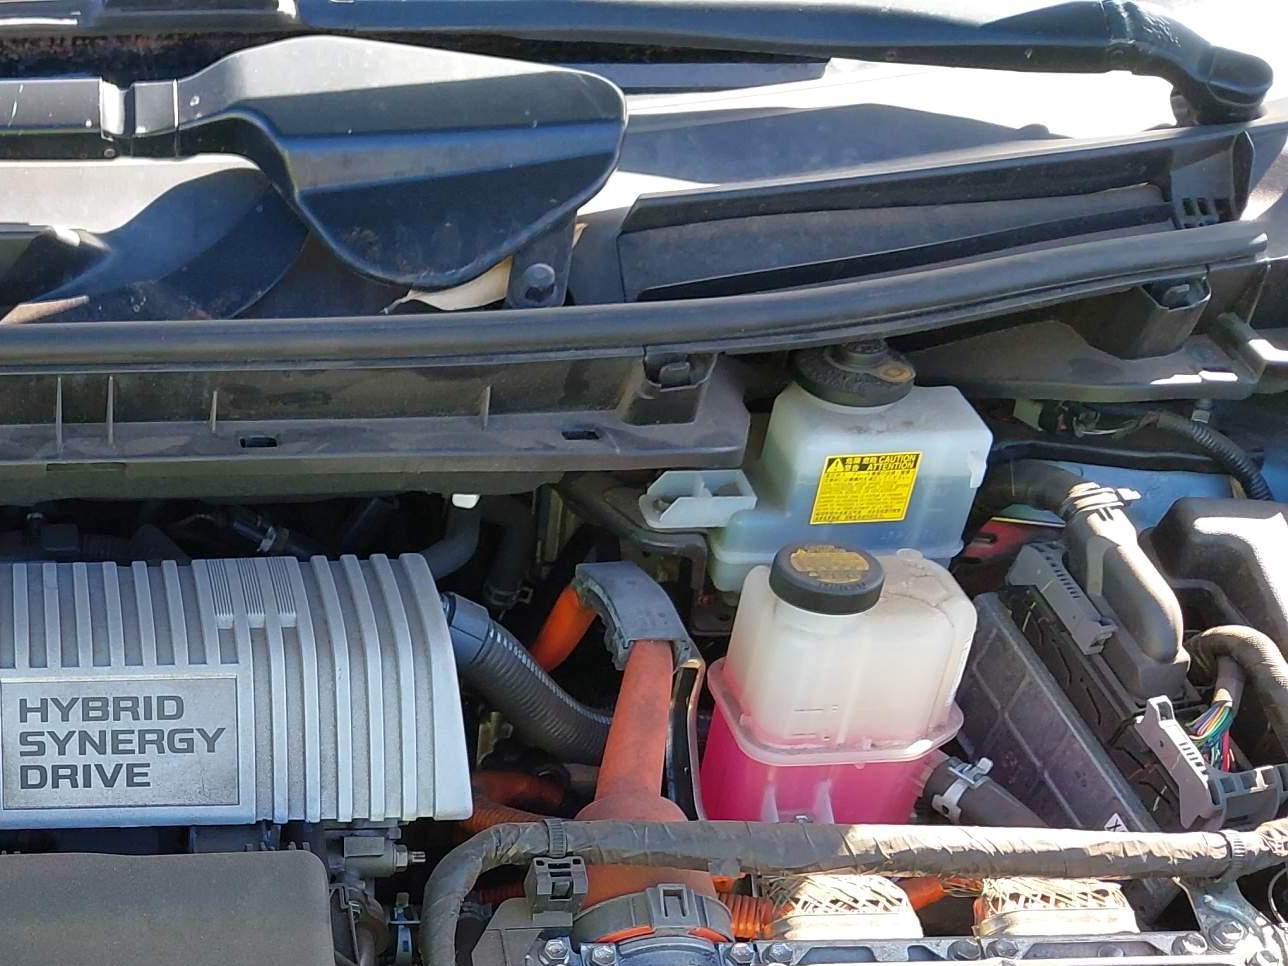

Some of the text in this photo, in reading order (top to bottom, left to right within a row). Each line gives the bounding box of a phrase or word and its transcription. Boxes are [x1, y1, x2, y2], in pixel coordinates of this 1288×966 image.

[867, 462, 913, 470] ATTENTION
[879, 455, 916, 463] CAUTION
[19, 695, 184, 723] HYBRID
[19, 727, 226, 757] SYNERGY
[19, 762, 151, 790] DRIVE
